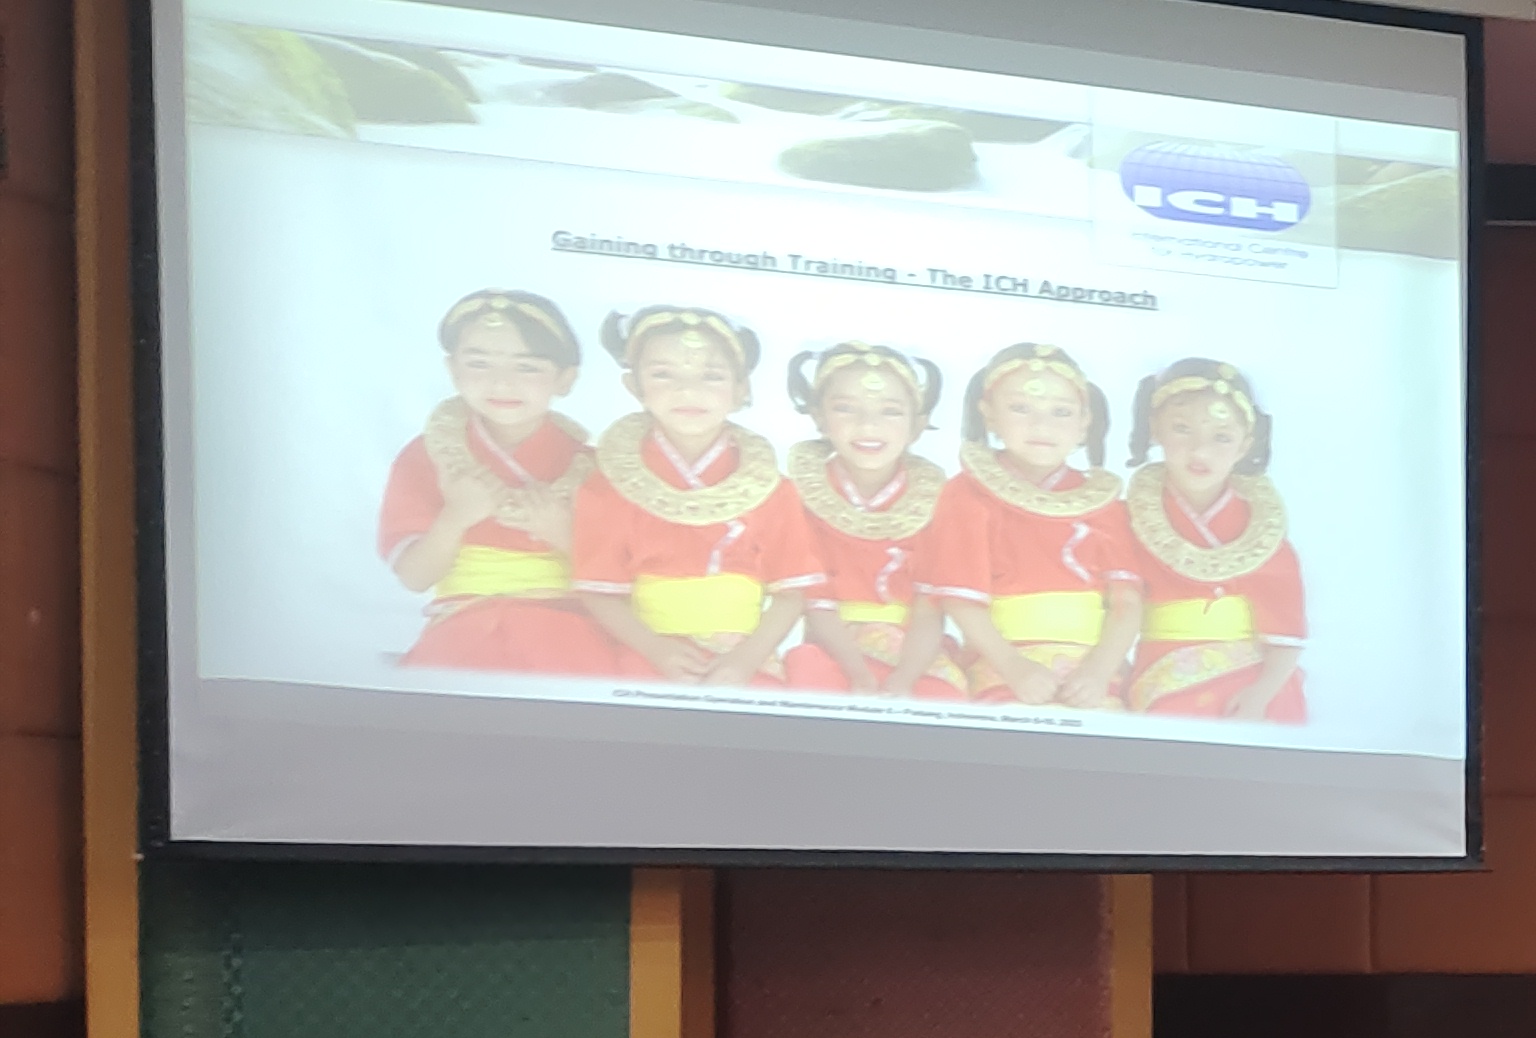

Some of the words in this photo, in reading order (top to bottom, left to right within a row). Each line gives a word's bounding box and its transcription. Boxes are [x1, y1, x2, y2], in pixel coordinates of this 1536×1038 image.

[1134, 185, 1298, 222] ICH
[551, 230, 659, 258] Gaining
[667, 243, 777, 268] through
[788, 254, 897, 281] Training
[927, 268, 973, 288] The
[983, 274, 1029, 293] ICH
[1038, 279, 1158, 308] Approach
